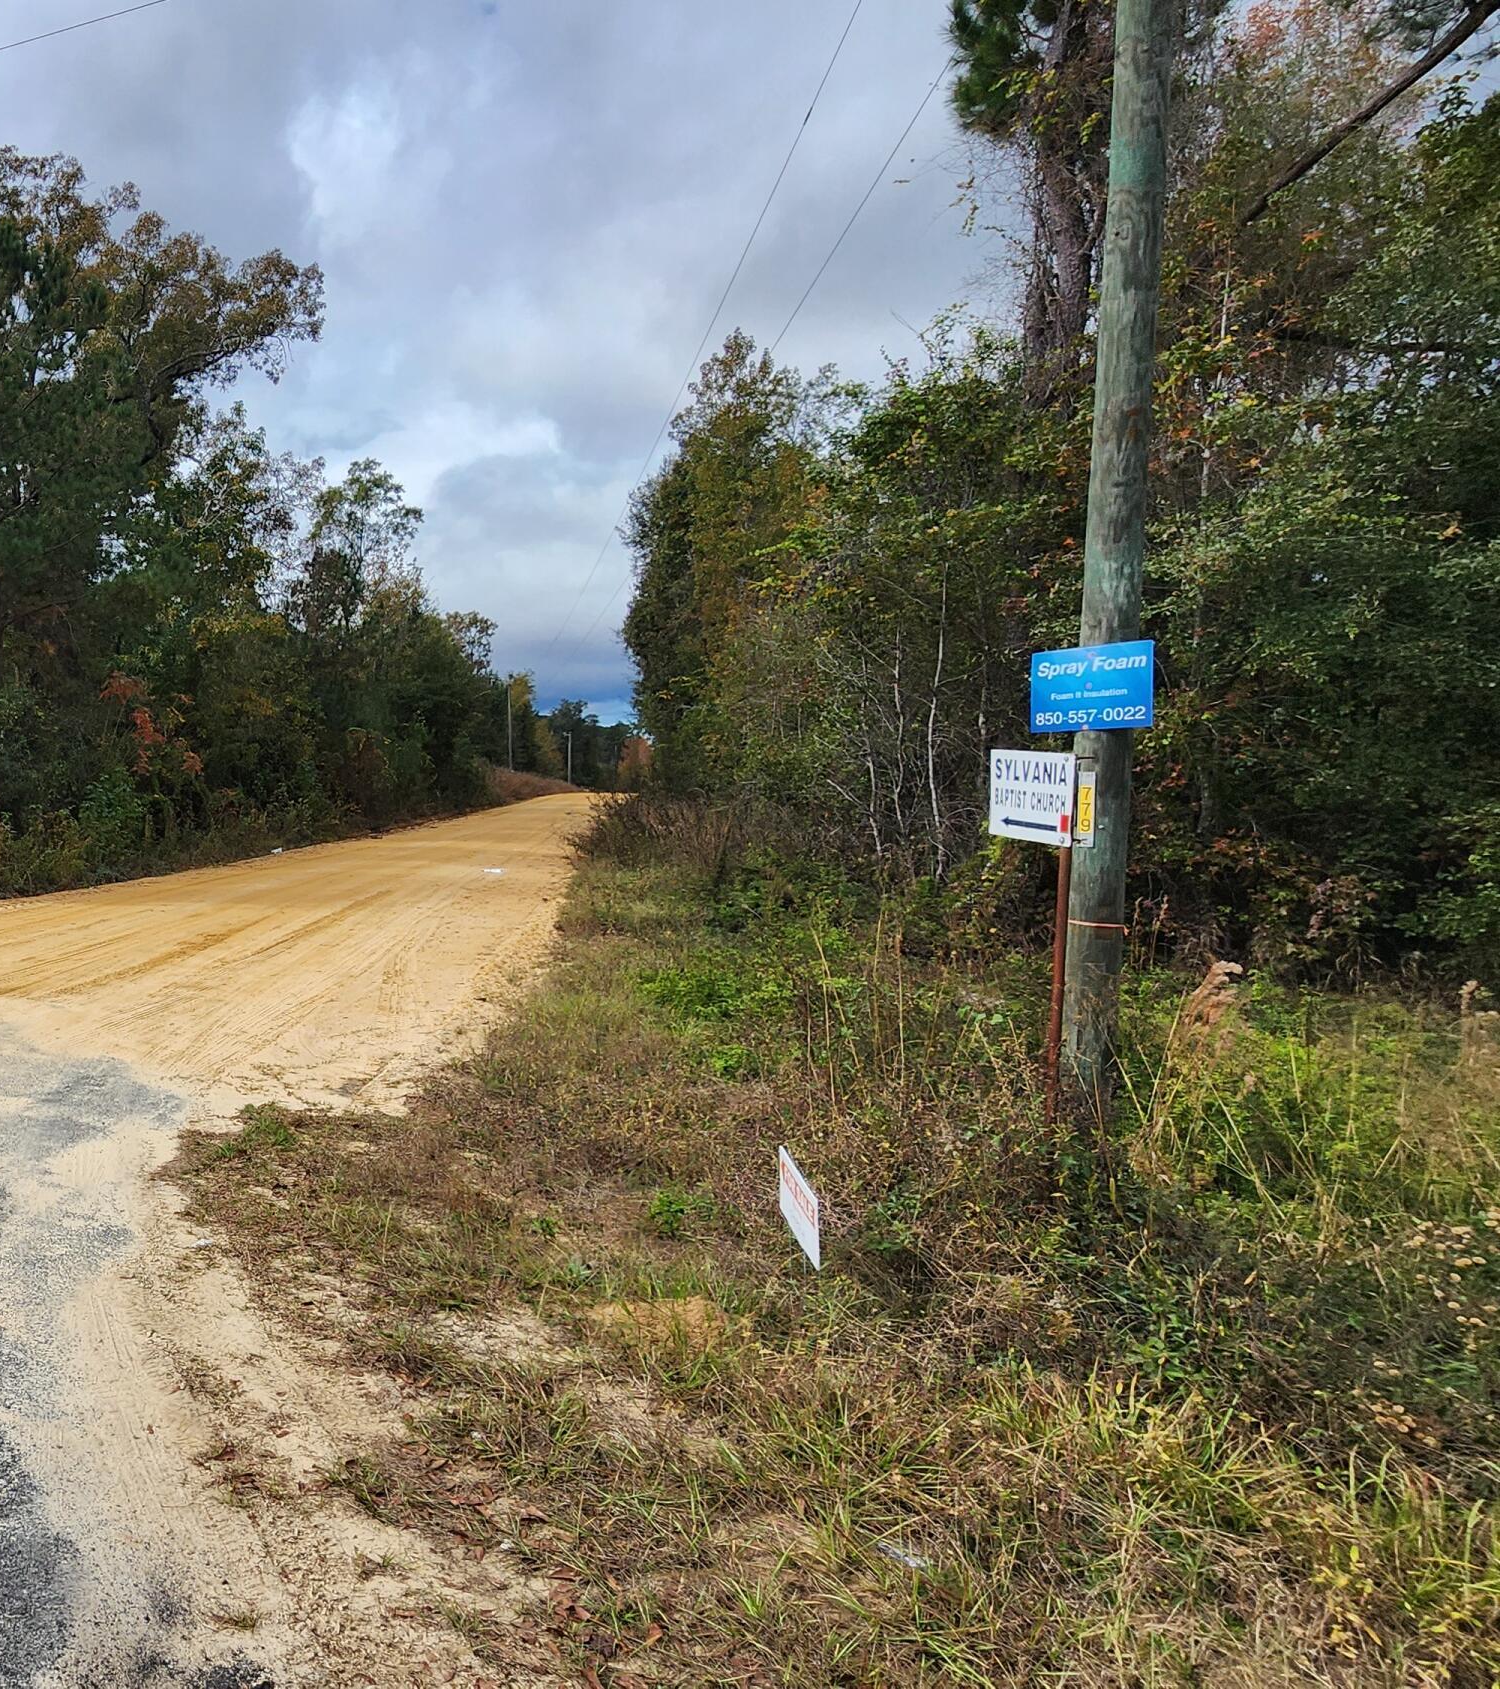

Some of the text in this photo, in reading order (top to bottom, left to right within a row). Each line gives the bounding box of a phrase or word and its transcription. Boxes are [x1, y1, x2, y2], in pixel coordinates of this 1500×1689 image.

[1037, 655, 1147, 680] Spray Foam
[1050, 692, 1074, 700] Foam
[1083, 688, 1128, 698] Insulation
[1035, 706, 1146, 726] 850-557-0022
[995, 758, 1067, 786] SYLVANIA
[995, 787, 1067, 814] BAPTIST CHURCH
